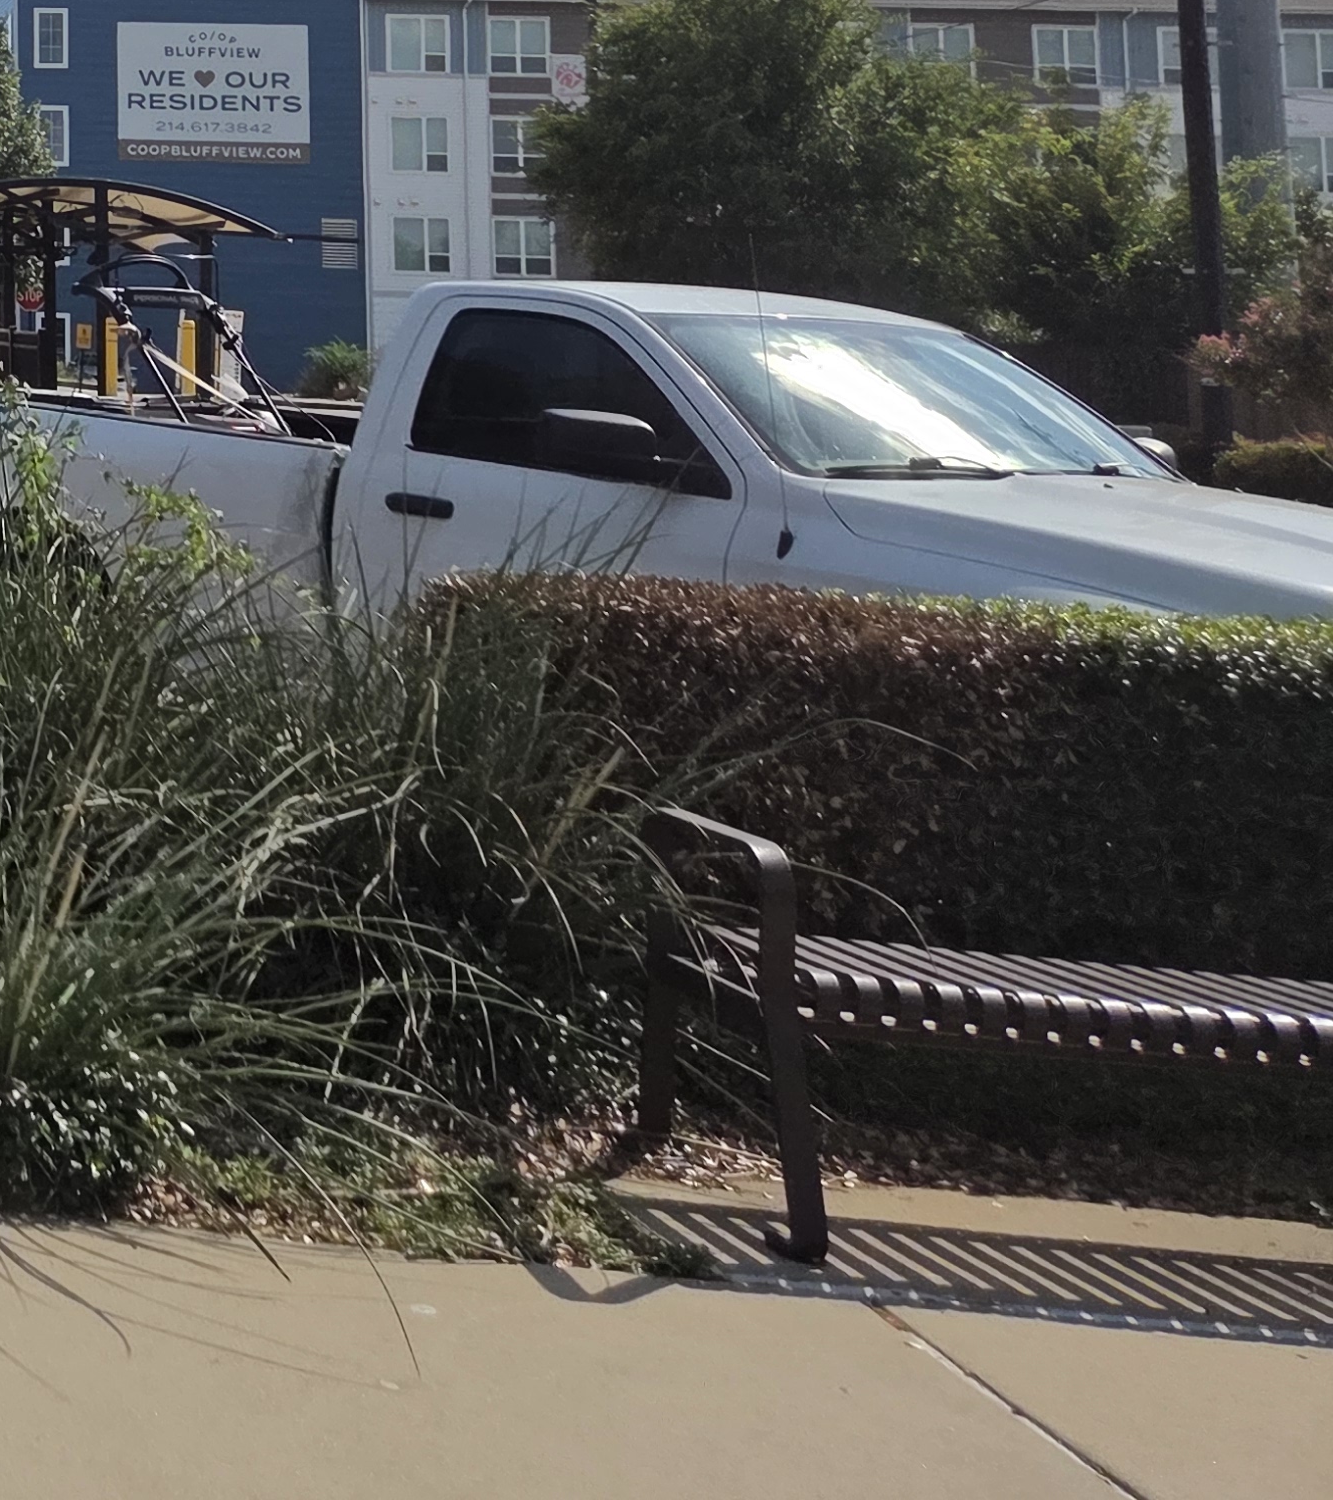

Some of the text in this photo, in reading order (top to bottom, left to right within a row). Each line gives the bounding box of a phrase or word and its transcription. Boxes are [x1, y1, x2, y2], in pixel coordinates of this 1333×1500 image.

[164, 46, 261, 59] BLUFFVIEW
[138, 69, 291, 89] WE OUR
[127, 93, 303, 113] RESIDENTS
[155, 121, 273, 134] 214.617.3842
[127, 144, 302, 159] COOPBLUFFVIEW.COM
